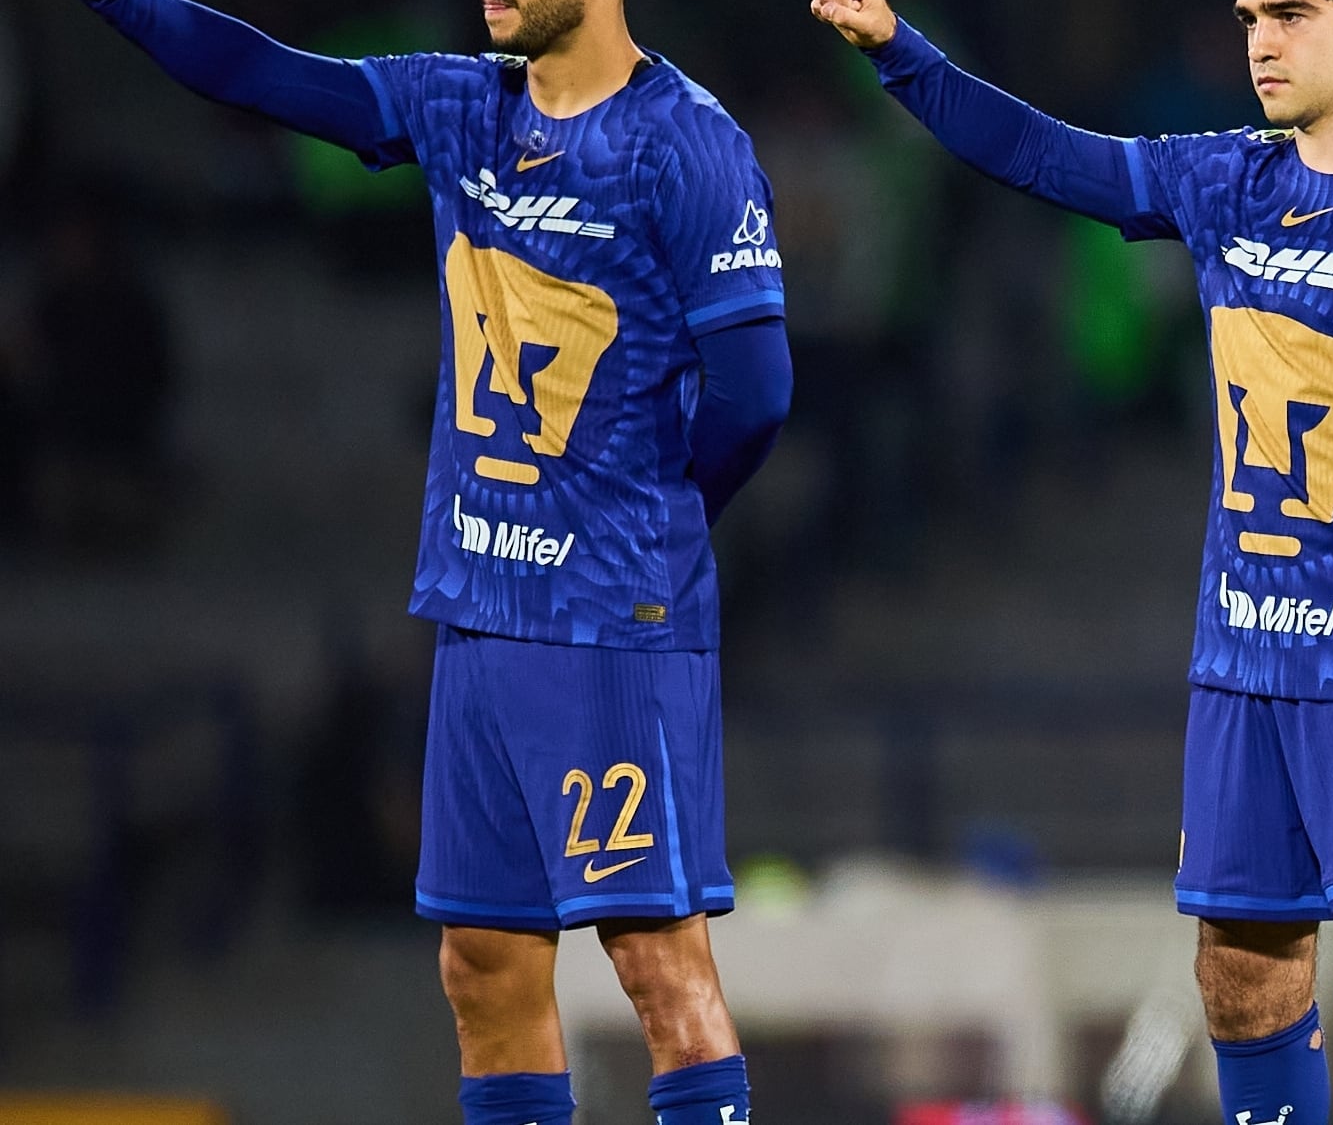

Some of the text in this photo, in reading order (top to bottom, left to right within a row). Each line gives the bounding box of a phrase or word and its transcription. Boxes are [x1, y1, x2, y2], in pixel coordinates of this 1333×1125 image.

[476, 168, 584, 234] DHL
[492, 521, 575, 567] Mifel
[562, 762, 654, 857] 22
